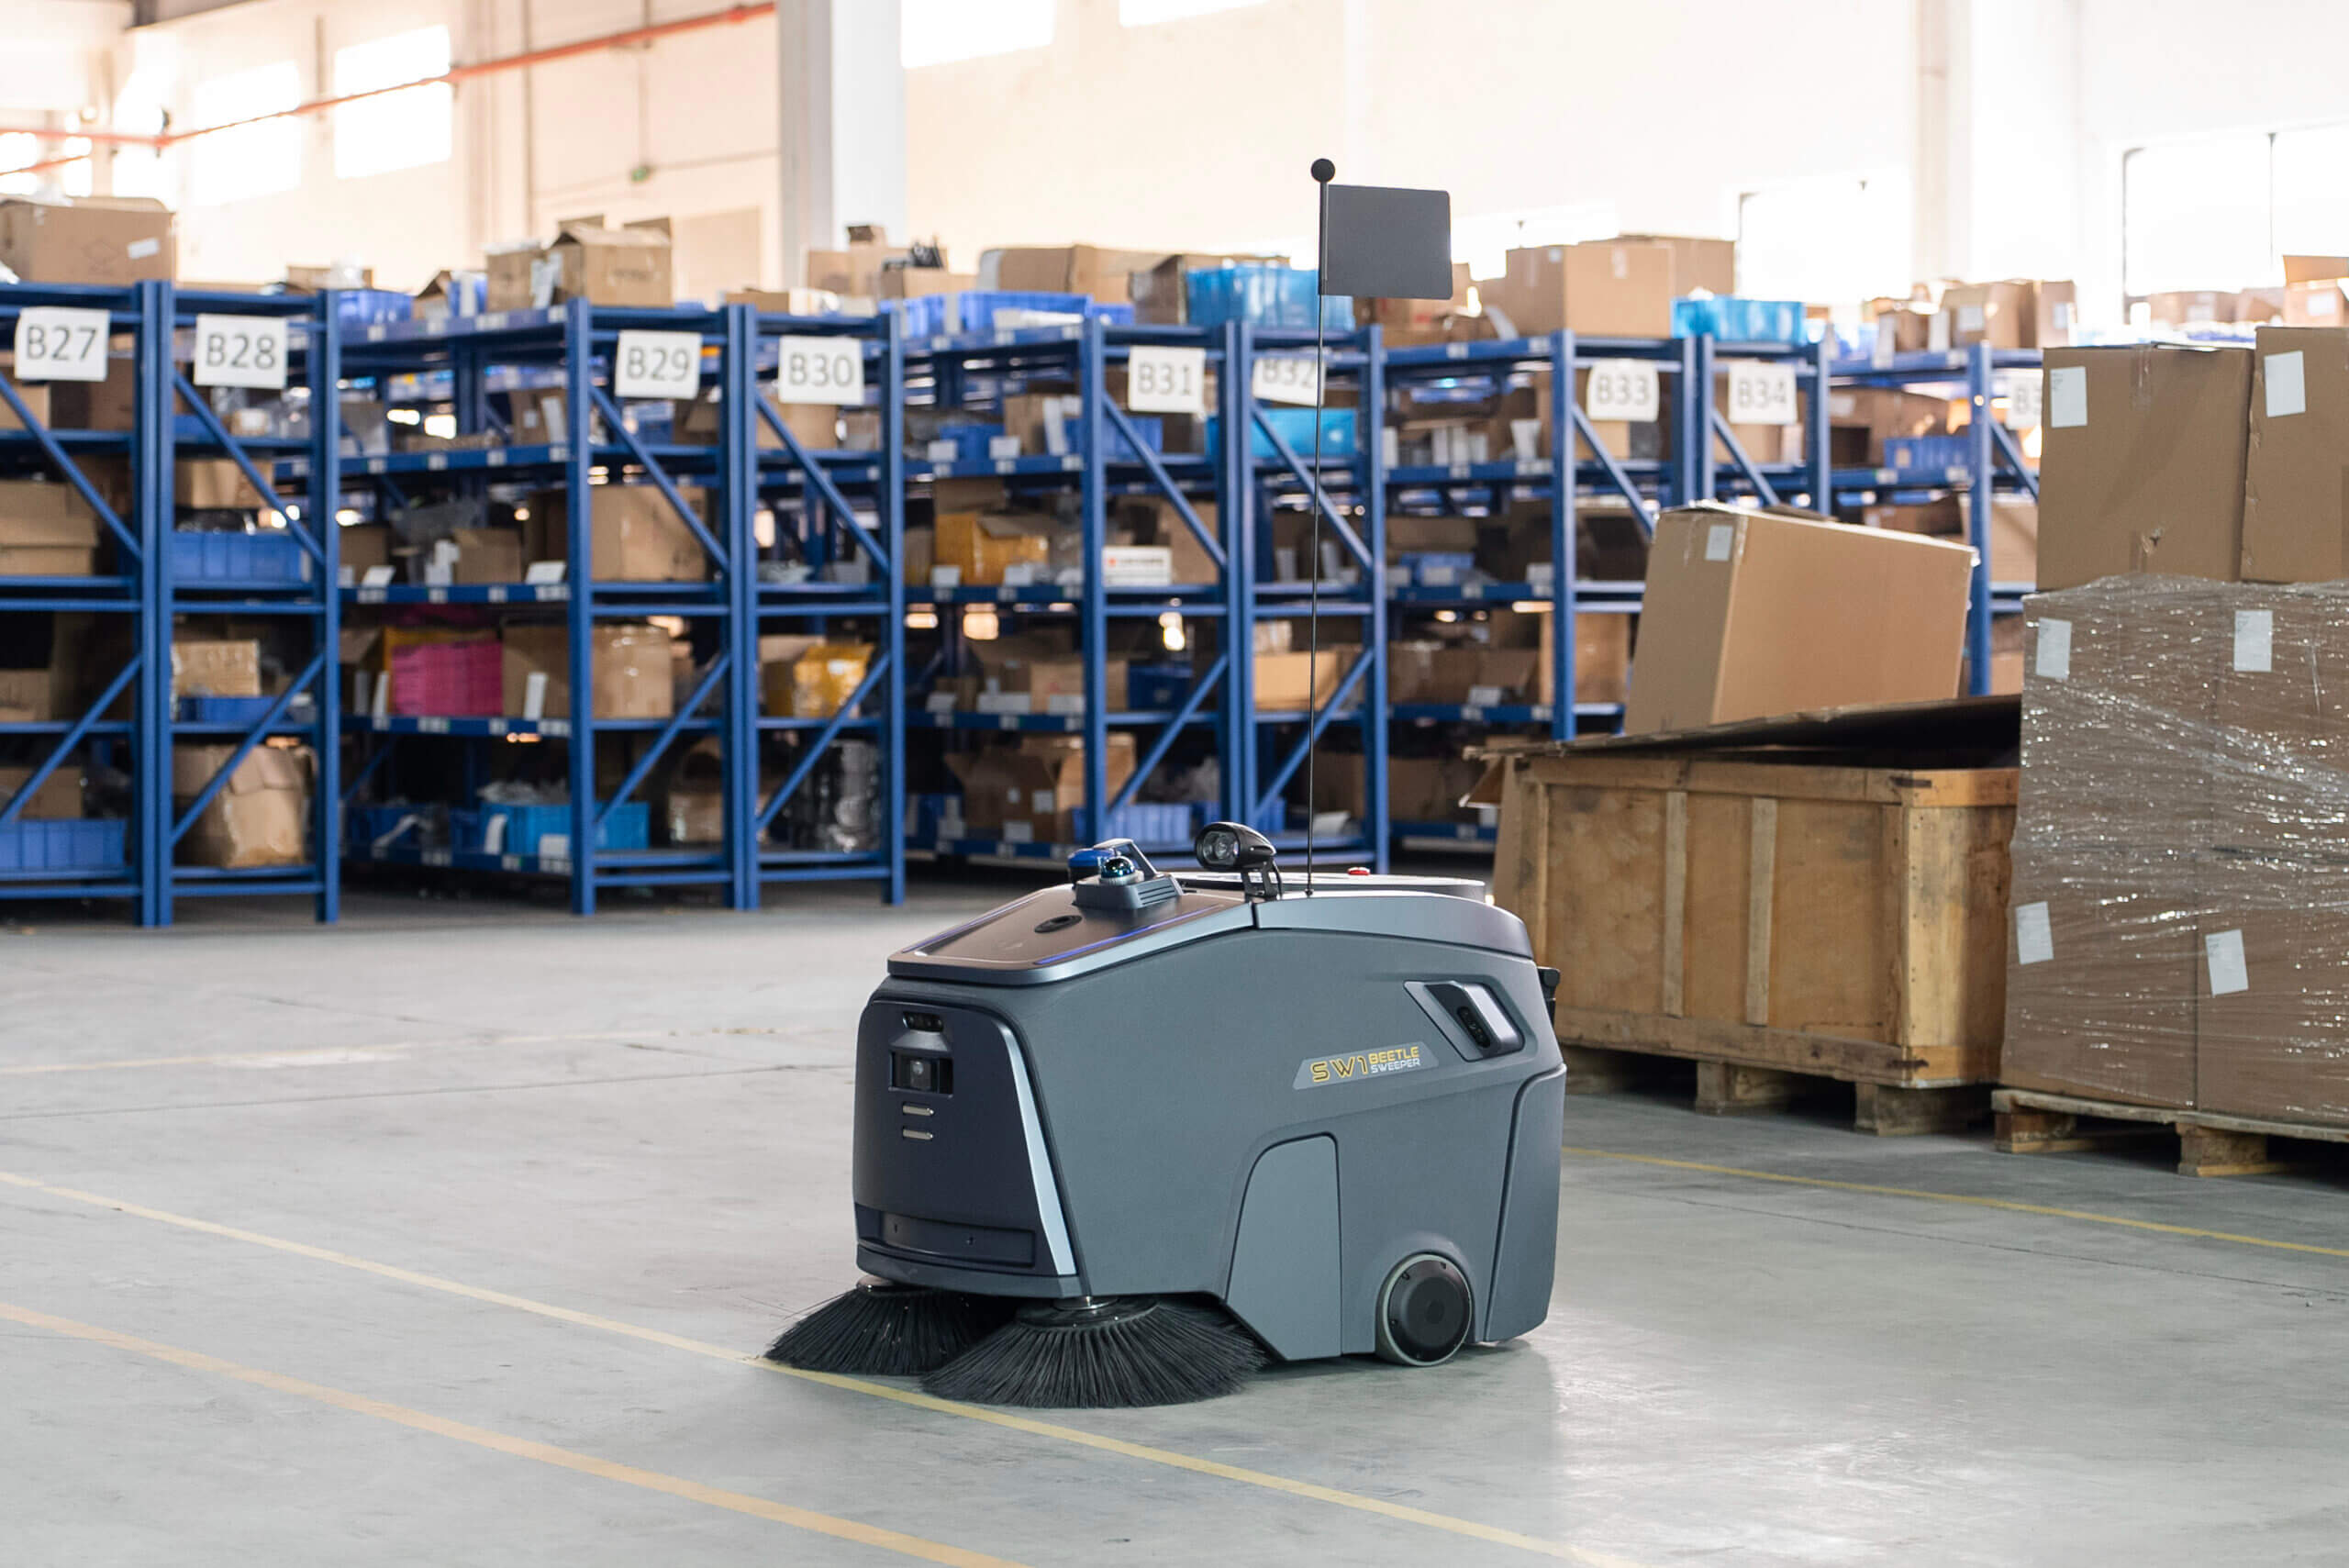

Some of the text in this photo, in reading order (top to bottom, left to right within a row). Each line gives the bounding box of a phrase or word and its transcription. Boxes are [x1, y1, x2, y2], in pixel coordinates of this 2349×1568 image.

[27, 325, 97, 360] B27
[206, 333, 276, 369] B28
[626, 345, 690, 381] B29
[788, 352, 853, 386] B30
[1138, 362, 1191, 395] B31
[1597, 373, 1649, 405] B33
[1738, 375, 1787, 408] B34
[1310, 1055, 1368, 1083] SW1
[1368, 1046, 1419, 1064] BEETLE
[1371, 1058, 1421, 1073] SWEEPER
